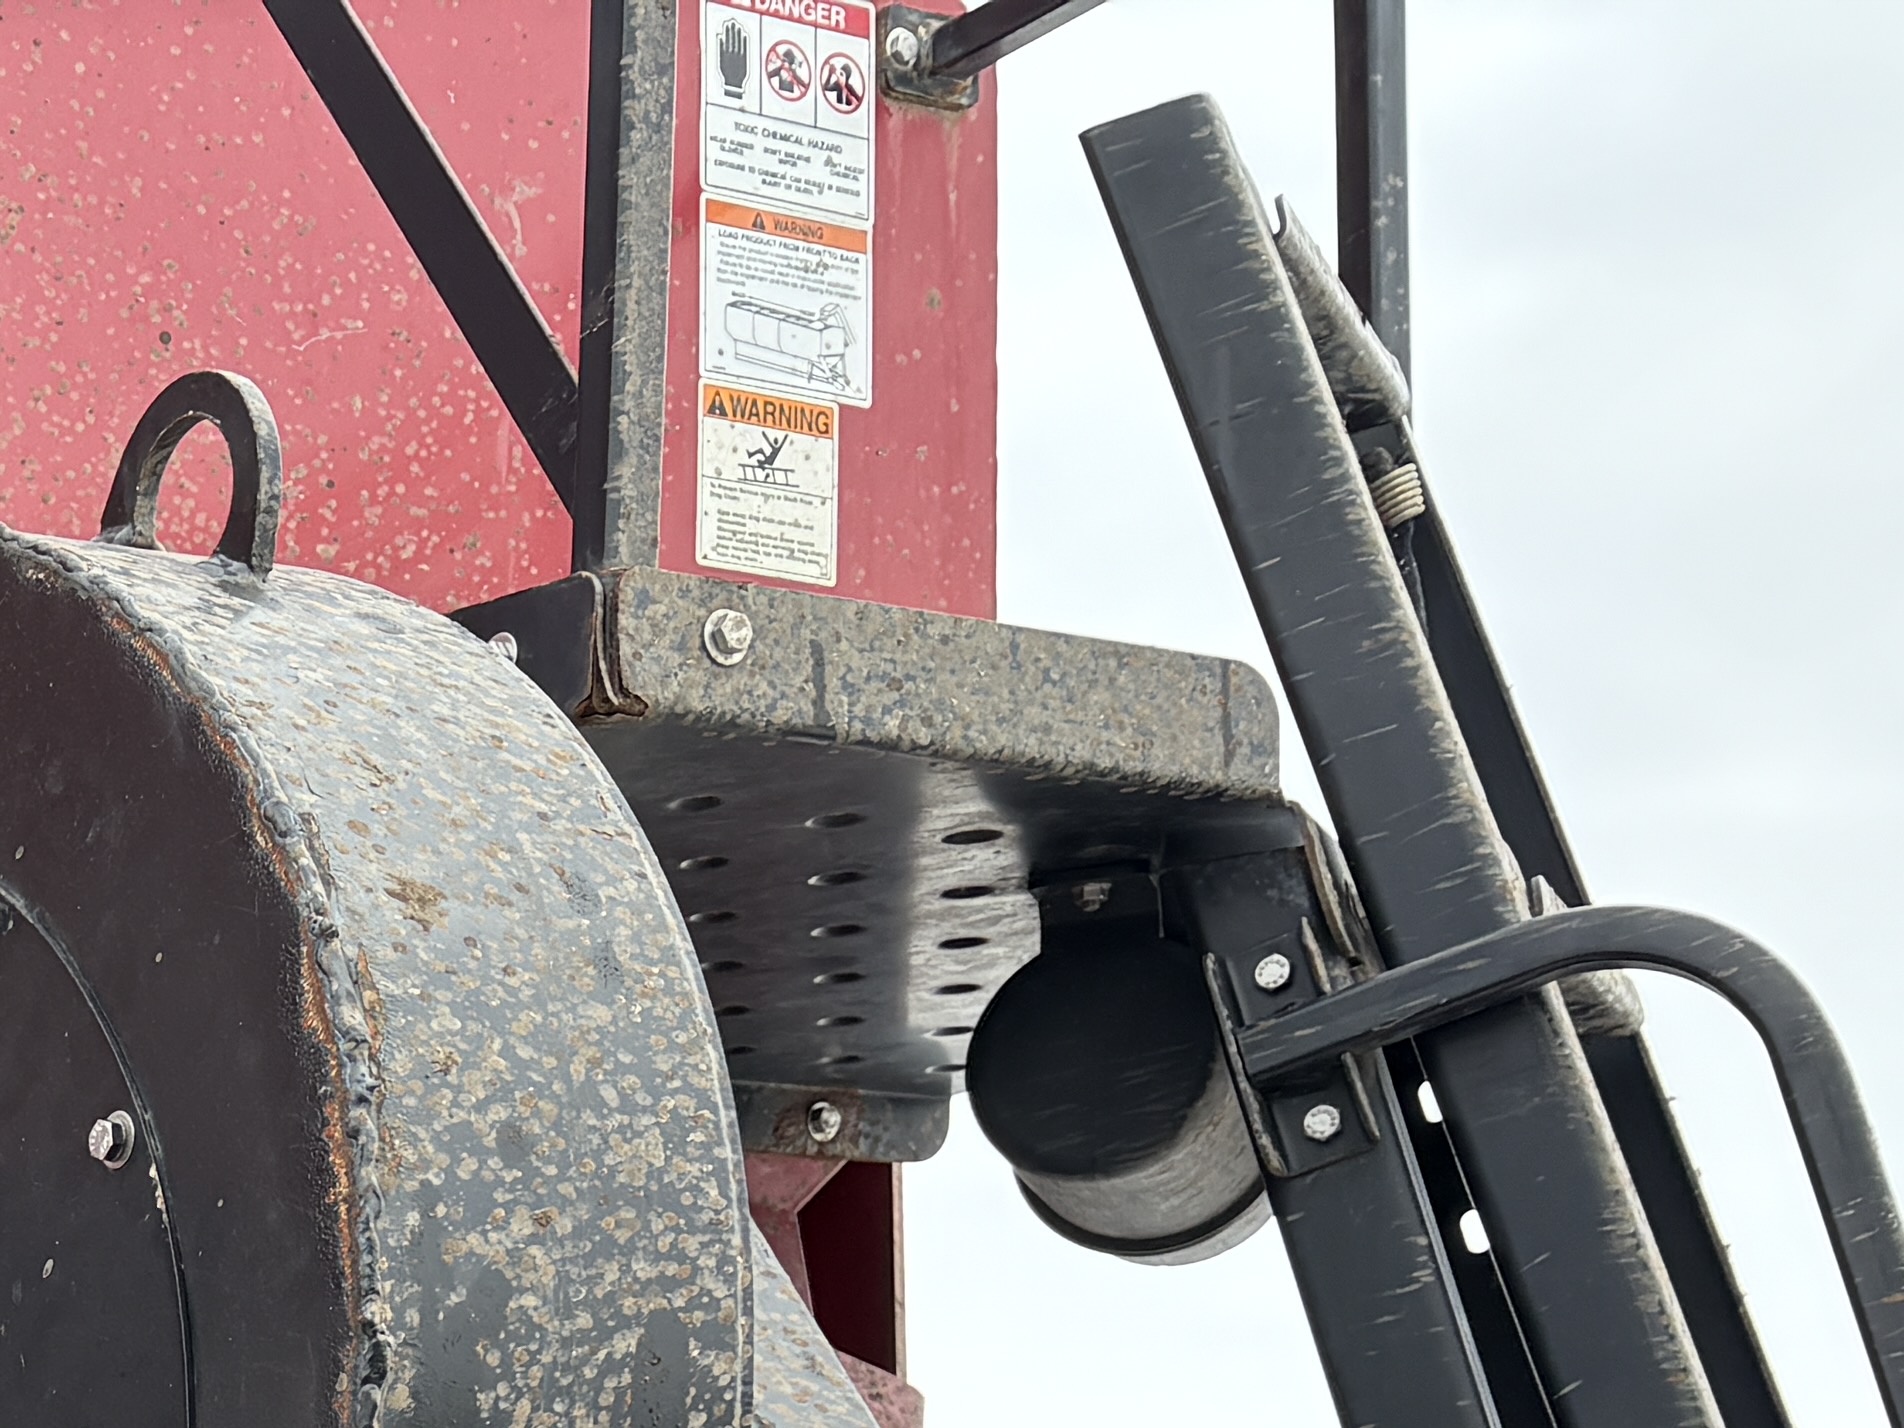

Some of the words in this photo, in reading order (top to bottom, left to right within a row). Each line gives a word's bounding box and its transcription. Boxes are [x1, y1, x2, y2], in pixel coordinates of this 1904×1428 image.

[754, 0, 846, 30] DANGER
[734, 121, 758, 136] TOXIC
[761, 127, 804, 146] CHEMICAL
[807, 137, 843, 154] HAZARD
[772, 217, 824, 240] WARNING
[718, 229, 738, 240] LOAD
[741, 233, 776, 247] PRODUCT
[778, 240, 800, 252] FROM
[802, 245, 826, 256] FRONT
[827, 250, 838, 260] TO
[840, 254, 860, 264] BACK
[729, 393, 830, 435] WARNING
